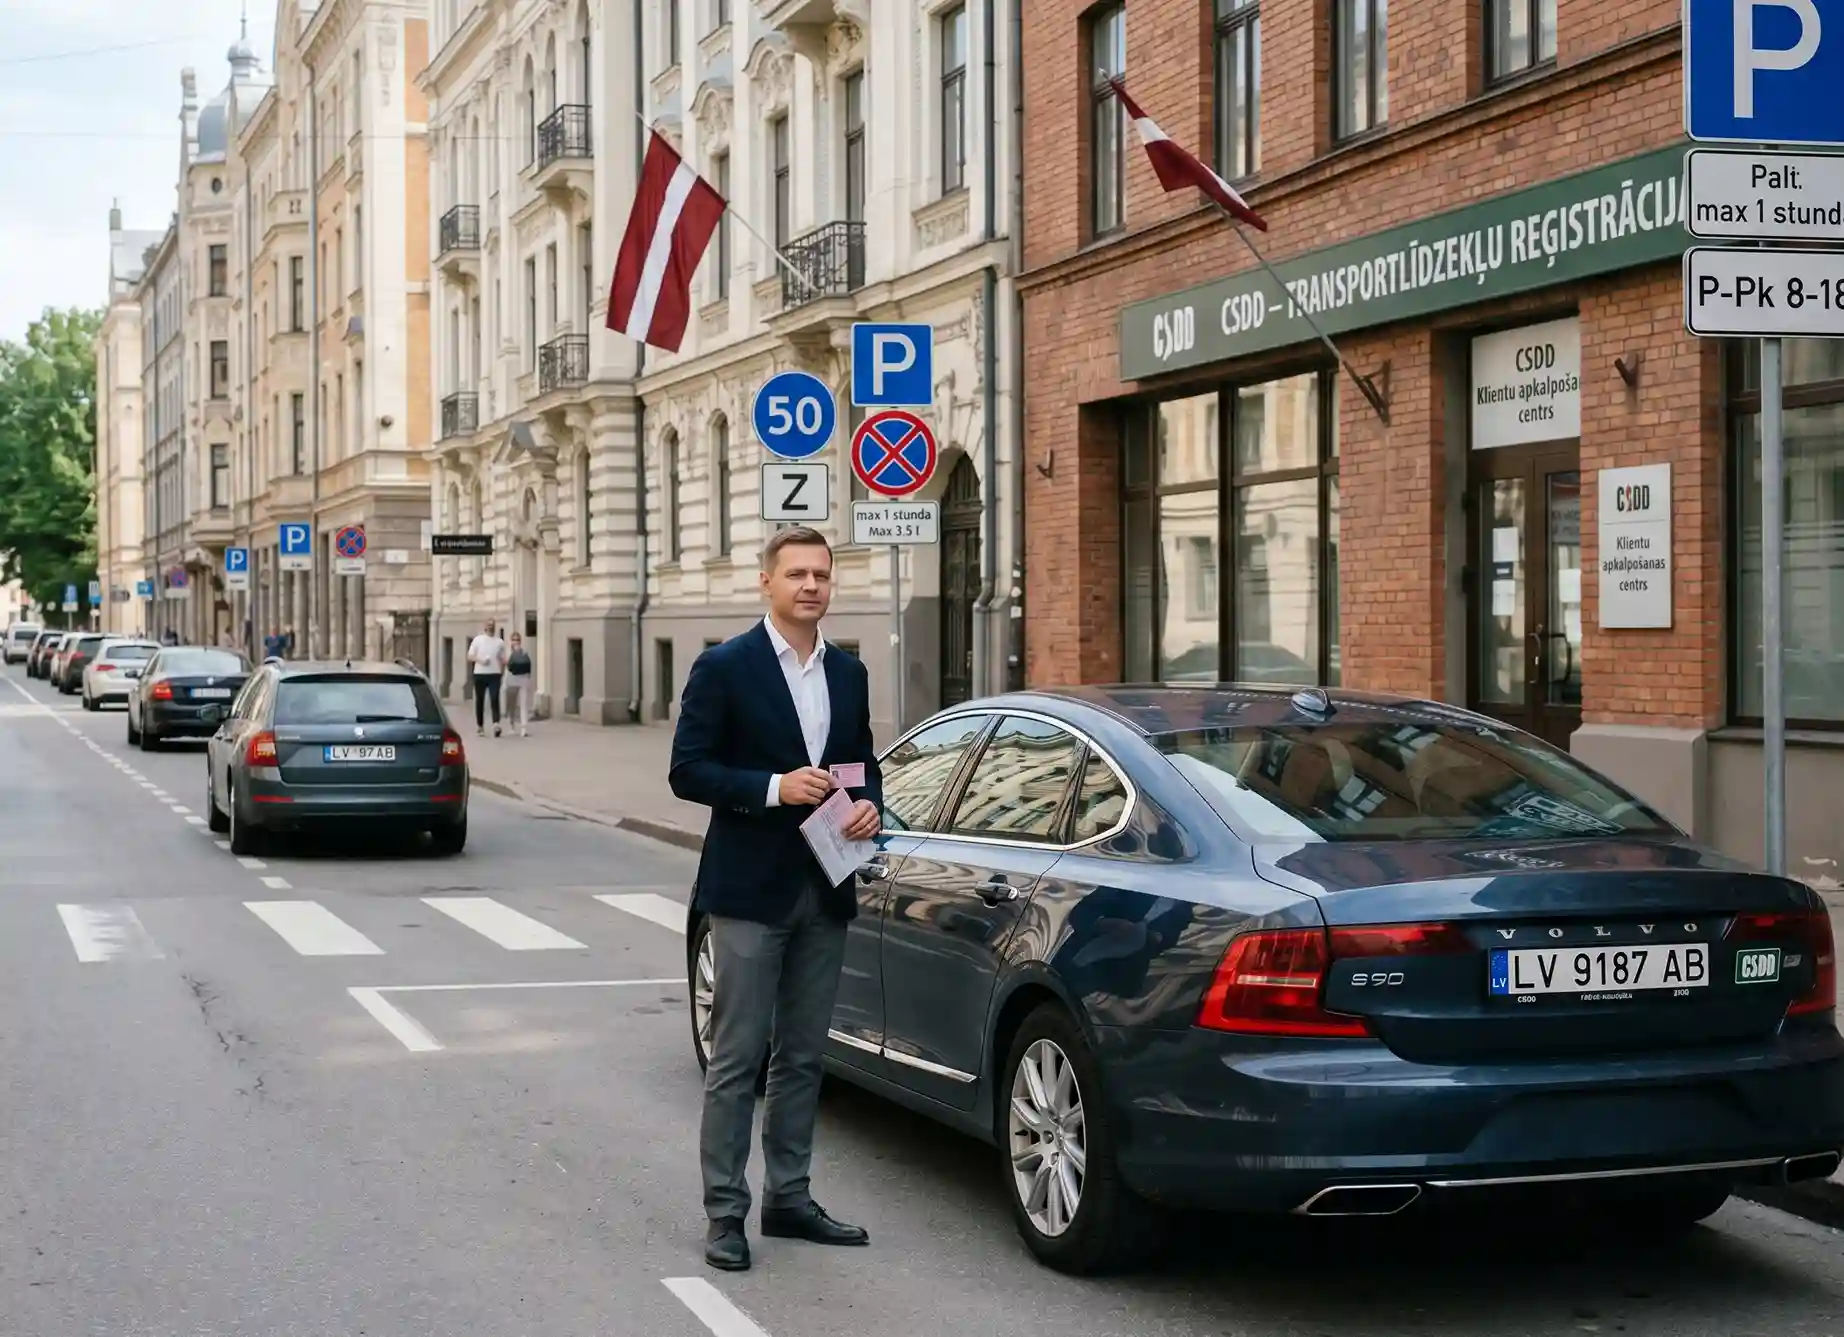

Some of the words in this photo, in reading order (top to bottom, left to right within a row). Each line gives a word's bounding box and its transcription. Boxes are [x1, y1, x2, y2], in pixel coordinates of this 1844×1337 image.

[1733, 0, 1822, 118] P
[1697, 203, 1748, 223] max
[1757, 198, 1764, 223] 1
[1774, 201, 1844, 225] stund
[1221, 291, 1265, 335] CSDD
[1285, 223, 1504, 320] TRANSPORTLĪDZEKĻU
[1699, 275, 1775, 309] P-Pk
[872, 333, 917, 396] P
[1516, 343, 1555, 373] CSDD
[1477, 383, 1516, 405] Klientu
[1519, 371, 1580, 402] apkalpoša
[768, 396, 822, 436] 50
[1518, 403, 1554, 424] centrs
[782, 473, 809, 511] Z
[856, 511, 881, 521] max
[884, 509, 889, 520] 1
[893, 508, 931, 521] stunda
[286, 526, 306, 552] P
[869, 526, 893, 537] Max
[896, 525, 913, 537] 3.5
[1616, 536, 1650, 550] Klientu
[1602, 556, 1666, 575] apkalpošanas
[1619, 578, 1649, 592] centrs
[1350, 972, 1405, 987] S90
[1514, 953, 1558, 989] LV
[1573, 950, 1649, 987] 9187
[1662, 948, 1705, 983] AB
[1741, 954, 1776, 979] CSDD
[1492, 977, 1508, 988] LV
